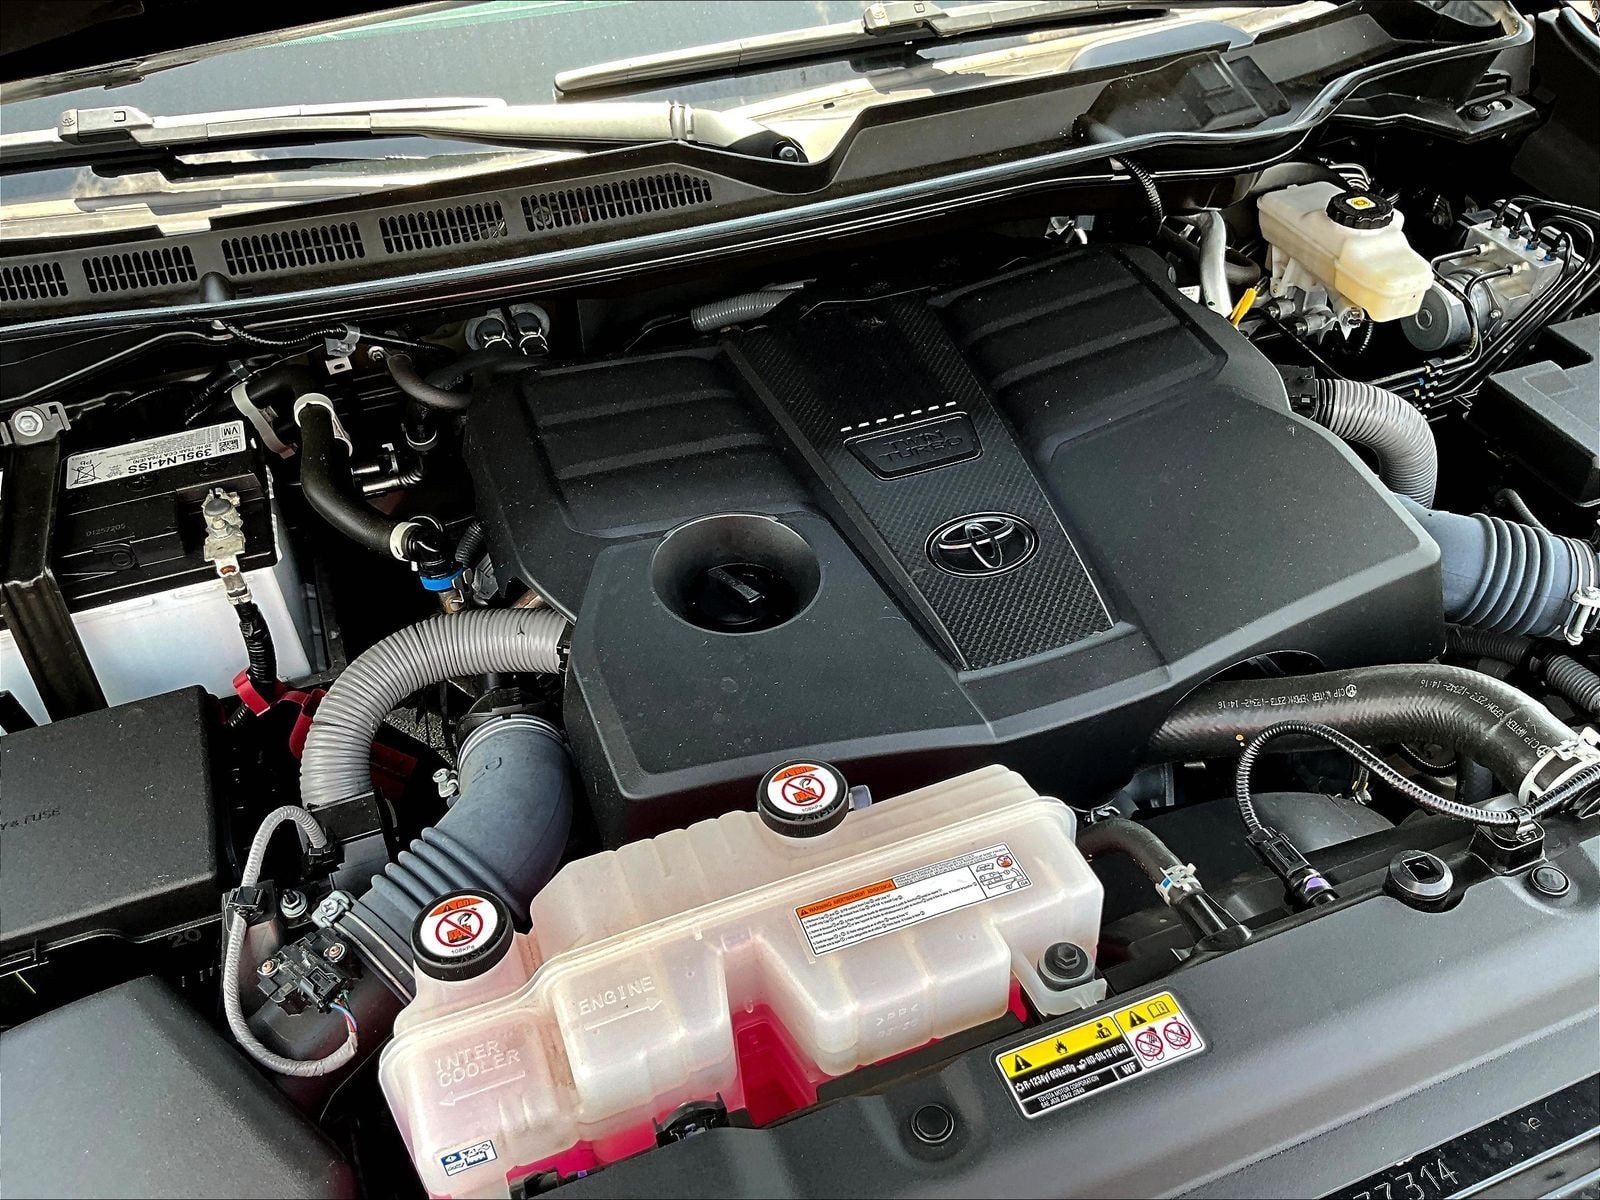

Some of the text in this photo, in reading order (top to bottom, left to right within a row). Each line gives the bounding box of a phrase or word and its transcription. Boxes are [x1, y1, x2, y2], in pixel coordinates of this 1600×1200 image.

[222, 425, 238, 436] VM
[127, 448, 212, 473] 395LN4-ISS
[808, 900, 832, 912] WARNING
[579, 976, 656, 1016] ENGINE
[434, 1039, 502, 1073] INTER
[438, 1049, 521, 1088] COOLER
[1037, 1061, 1137, 1103] TOYOTA MOTOR CORPORATION WF
